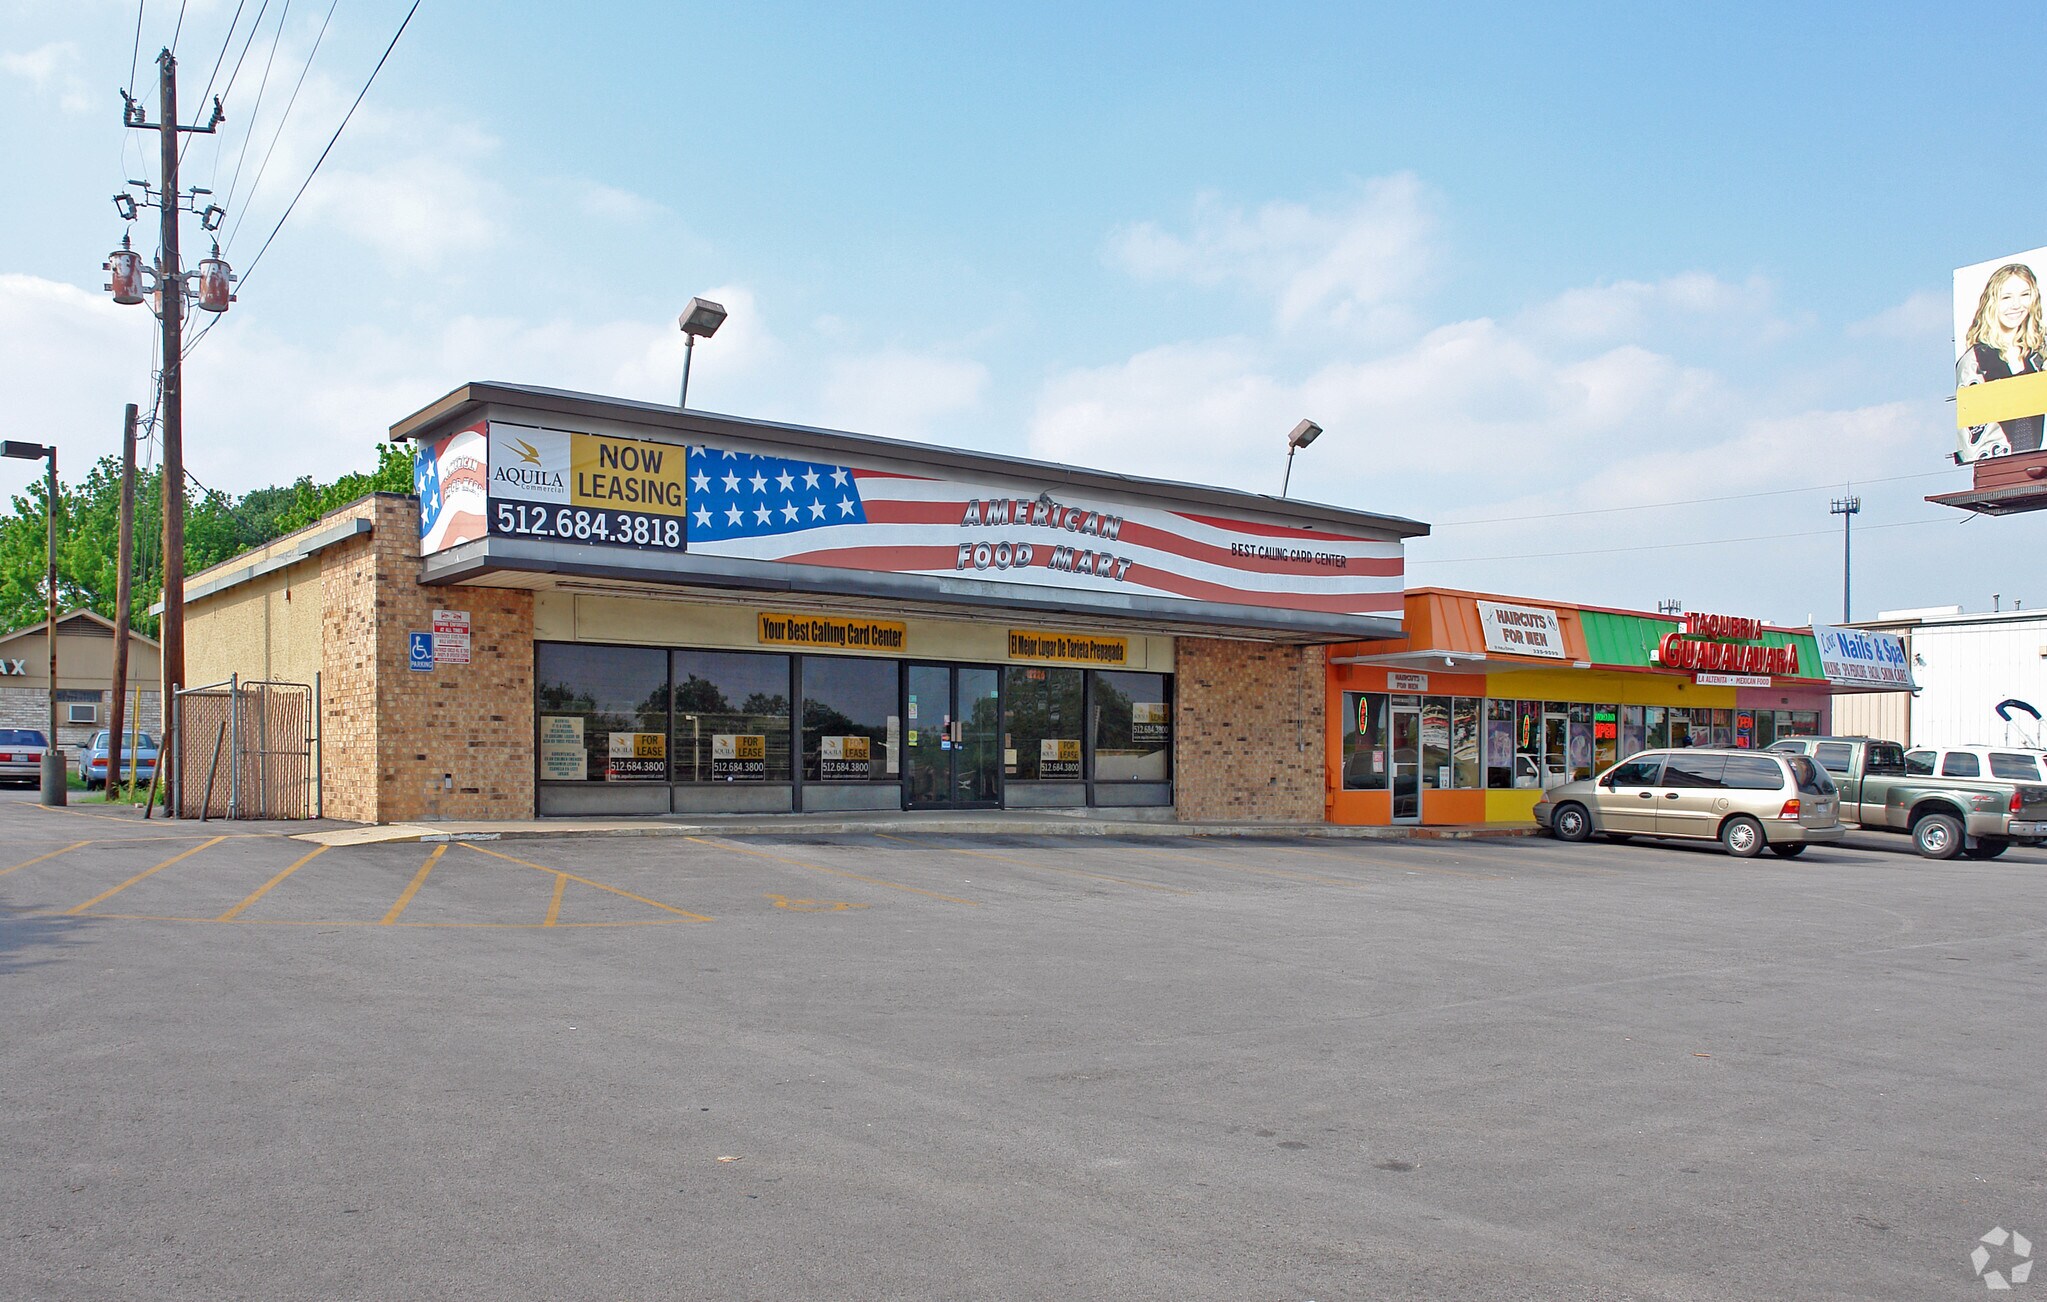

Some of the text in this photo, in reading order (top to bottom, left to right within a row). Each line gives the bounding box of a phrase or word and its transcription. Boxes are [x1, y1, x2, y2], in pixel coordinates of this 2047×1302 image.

[601, 444, 663, 474] NOW
[494, 466, 564, 487] AQUILA
[521, 483, 564, 494] Commercial
[579, 473, 681, 507] LEASING
[498, 504, 680, 548] 512.684.3818
[960, 498, 1123, 541] AMERICAN
[956, 541, 1132, 581] FOOD MART
[1231, 542, 1347, 568] BEST CALLING CARD CENTER
[1496, 609, 1547, 629] HAIRCUTS
[1685, 612, 1763, 640] TAQUERIA
[763, 617, 902, 647] Your Best Calling Card Center
[1502, 628, 1548, 647] FOR MEN
[1011, 635, 1017, 655] El
[1039, 637, 1056, 659] Lugar
[1057, 638, 1066, 657] De
[1067, 639, 1089, 660] Tarjeta
[1660, 632, 1799, 674] GUADALAJARA
[1837, 632, 1873, 660] Nails
[1874, 638, 1884, 662] &
[1883, 639, 1904, 668] Spa
[411, 661, 433, 669] PARKING
[1881, 667, 1894, 681] SKIN
[1894, 669, 1907, 682] CARE
[642, 735, 657, 745] FOR
[743, 737, 758, 746] FOR
[1063, 741, 1074, 749] FOR
[637, 747, 662, 756] LEASE
[739, 748, 762, 757] LEASE
[846, 749, 867, 757] LEASE
[611, 761, 664, 771] 512.684.3800
[714, 762, 763, 771] 512.684.3800
[823, 762, 868, 771] 512.684.3800
